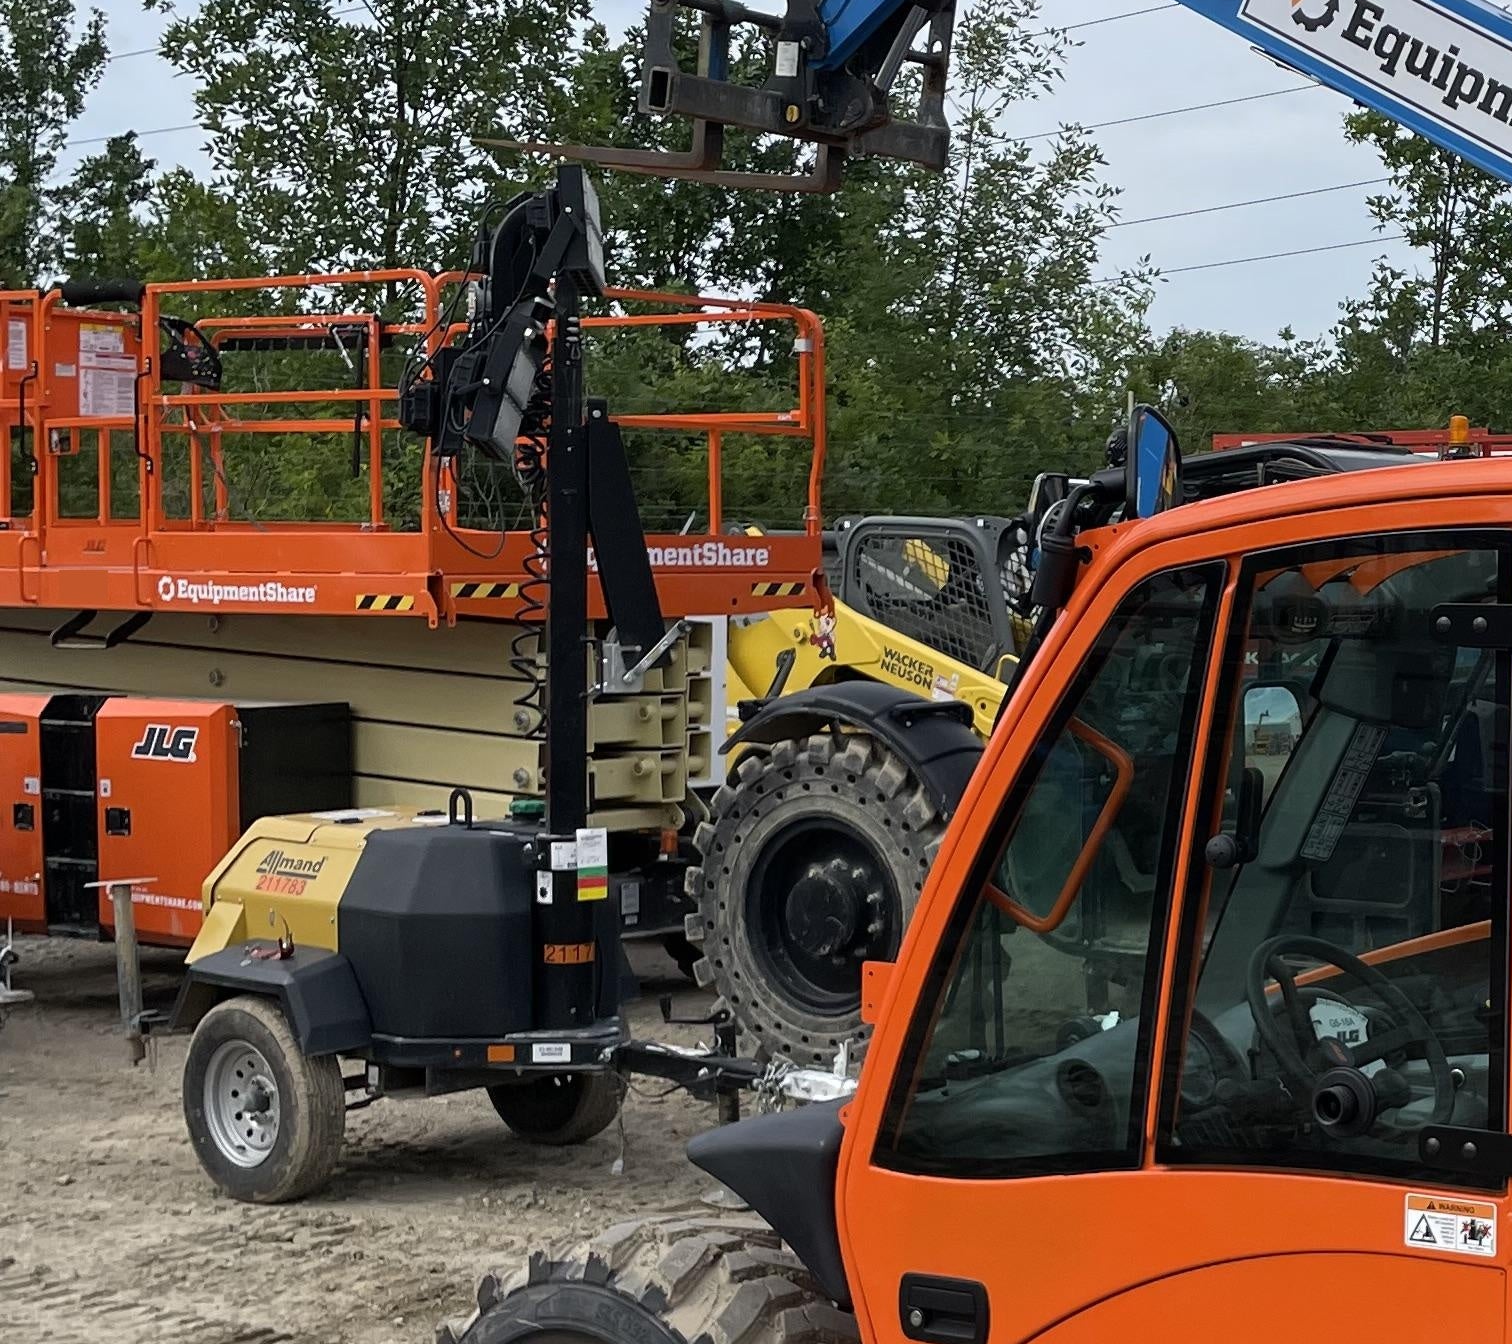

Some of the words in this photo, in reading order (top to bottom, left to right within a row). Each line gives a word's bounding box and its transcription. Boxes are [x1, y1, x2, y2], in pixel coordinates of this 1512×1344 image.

[177, 579, 316, 604] EquipmentShare
[884, 645, 934, 678] WACKER
[880, 659, 932, 691] NEUSON
[134, 726, 198, 760] JLG
[257, 850, 325, 875] Allmand
[256, 874, 307, 895] 211783
[1438, 1203, 1475, 1214] WARNING
